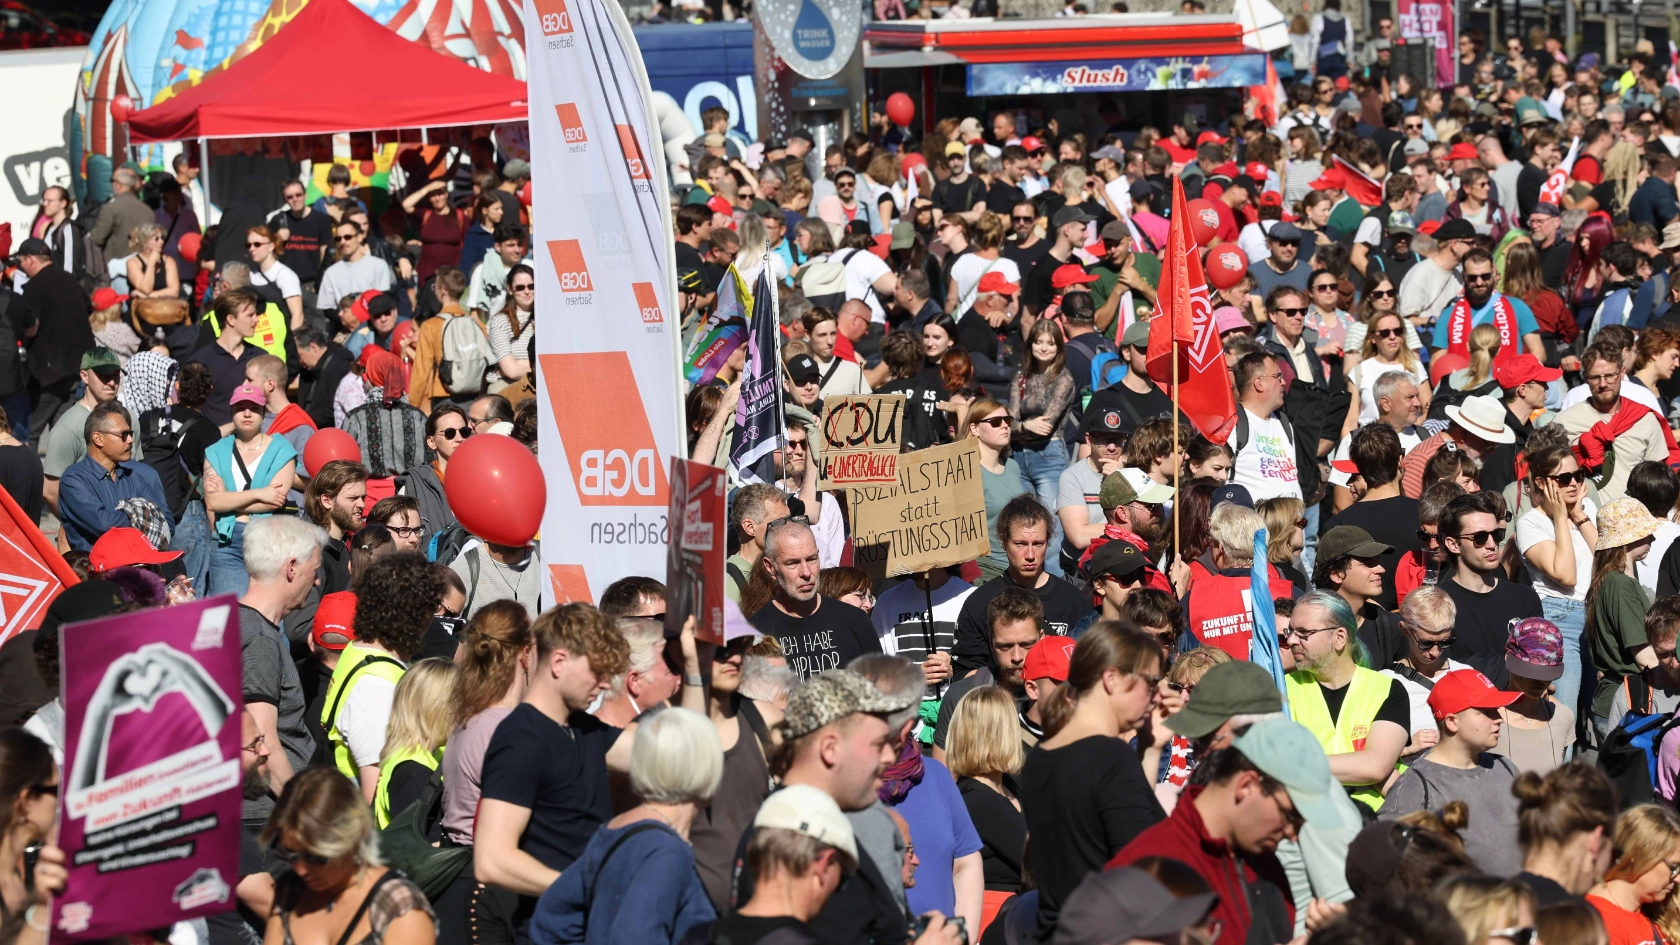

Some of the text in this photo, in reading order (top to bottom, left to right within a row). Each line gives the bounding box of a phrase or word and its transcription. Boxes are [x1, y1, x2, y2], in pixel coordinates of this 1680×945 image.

[796, 28, 829, 40] TRINK
[798, 40, 831, 48] WASSER
[1064, 67, 1125, 85] Slush
[13, 156, 72, 197] ve
[1452, 305, 1465, 344] WARM
[824, 398, 901, 448] CDU
[900, 496, 940, 522] statt
[856, 510, 985, 565] RÜSTUNGSSTAAT
[1202, 613, 1244, 631] ZUKUNFT
[1203, 622, 1252, 639] NUR MIT UN
[779, 630, 837, 655] ICH HABE
